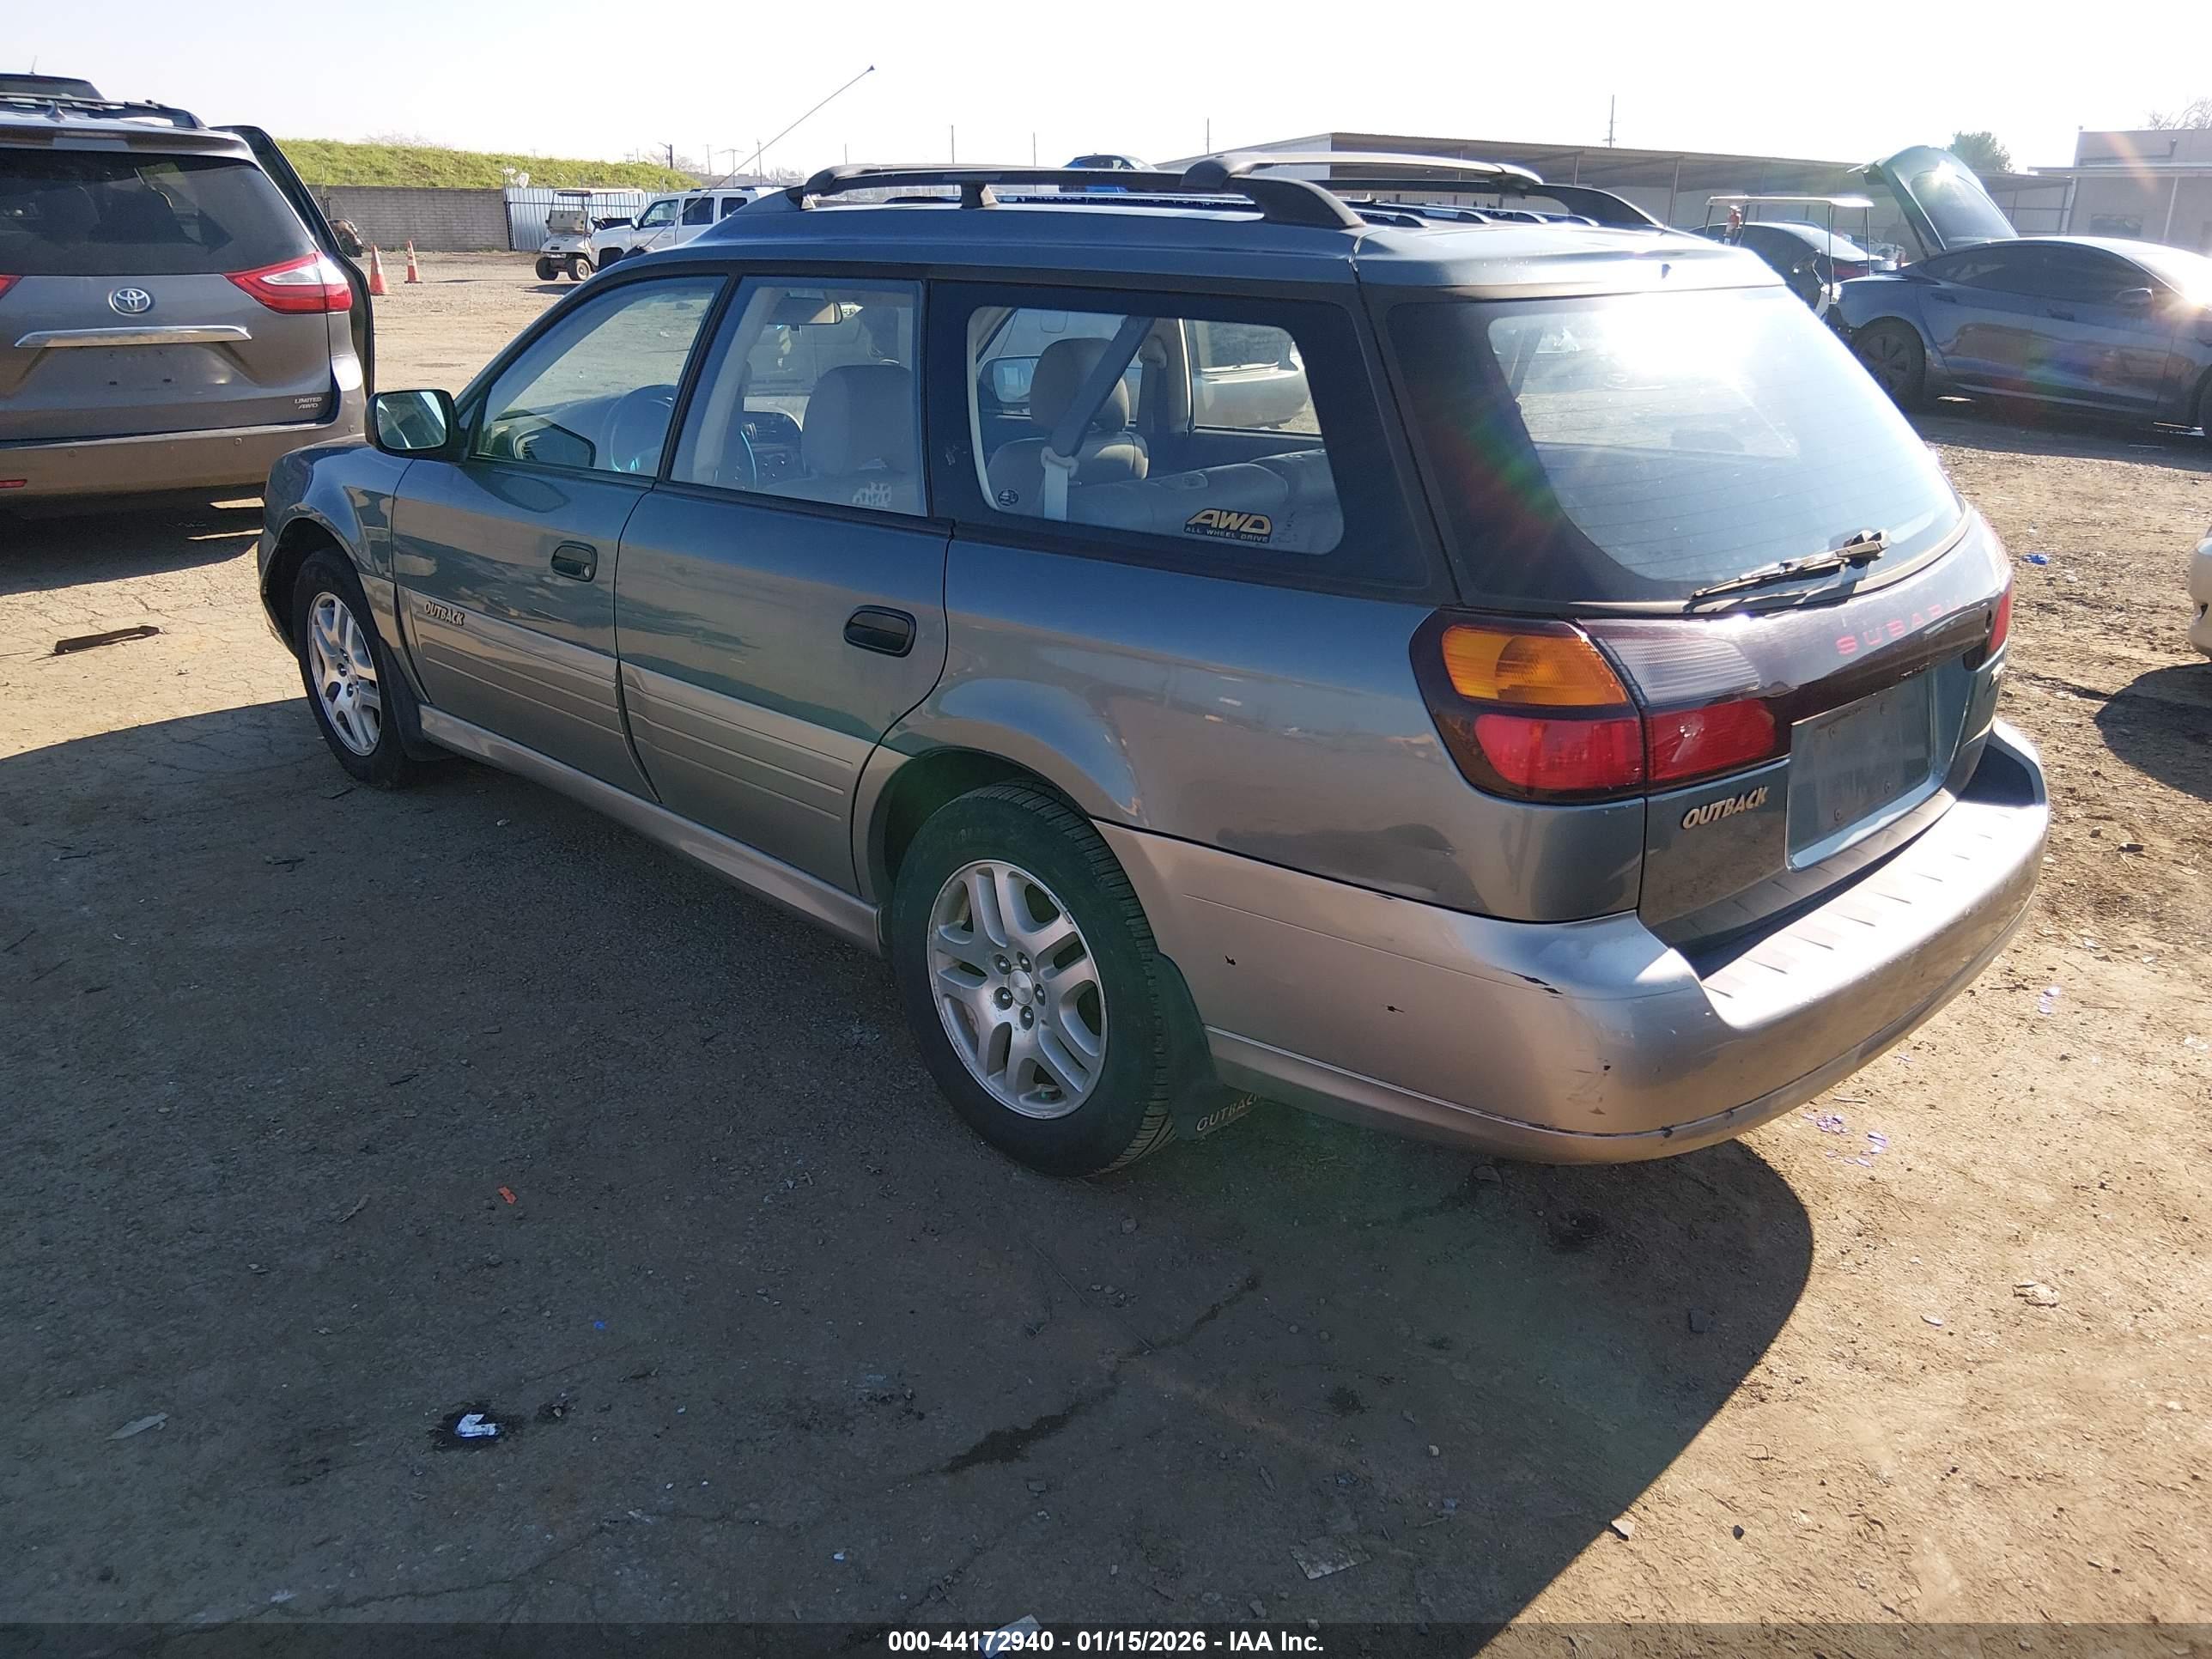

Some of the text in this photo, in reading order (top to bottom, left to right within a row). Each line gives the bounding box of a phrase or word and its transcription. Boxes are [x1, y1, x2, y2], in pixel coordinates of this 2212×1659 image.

[294, 396, 323, 404] LIMITED
[1186, 508, 1272, 535] AWD
[1206, 528, 1236, 538] WHEEL
[1240, 532, 1269, 544] DRIVE
[424, 601, 465, 626] OUTBACK
[1681, 786, 1770, 830] OUTBACK
